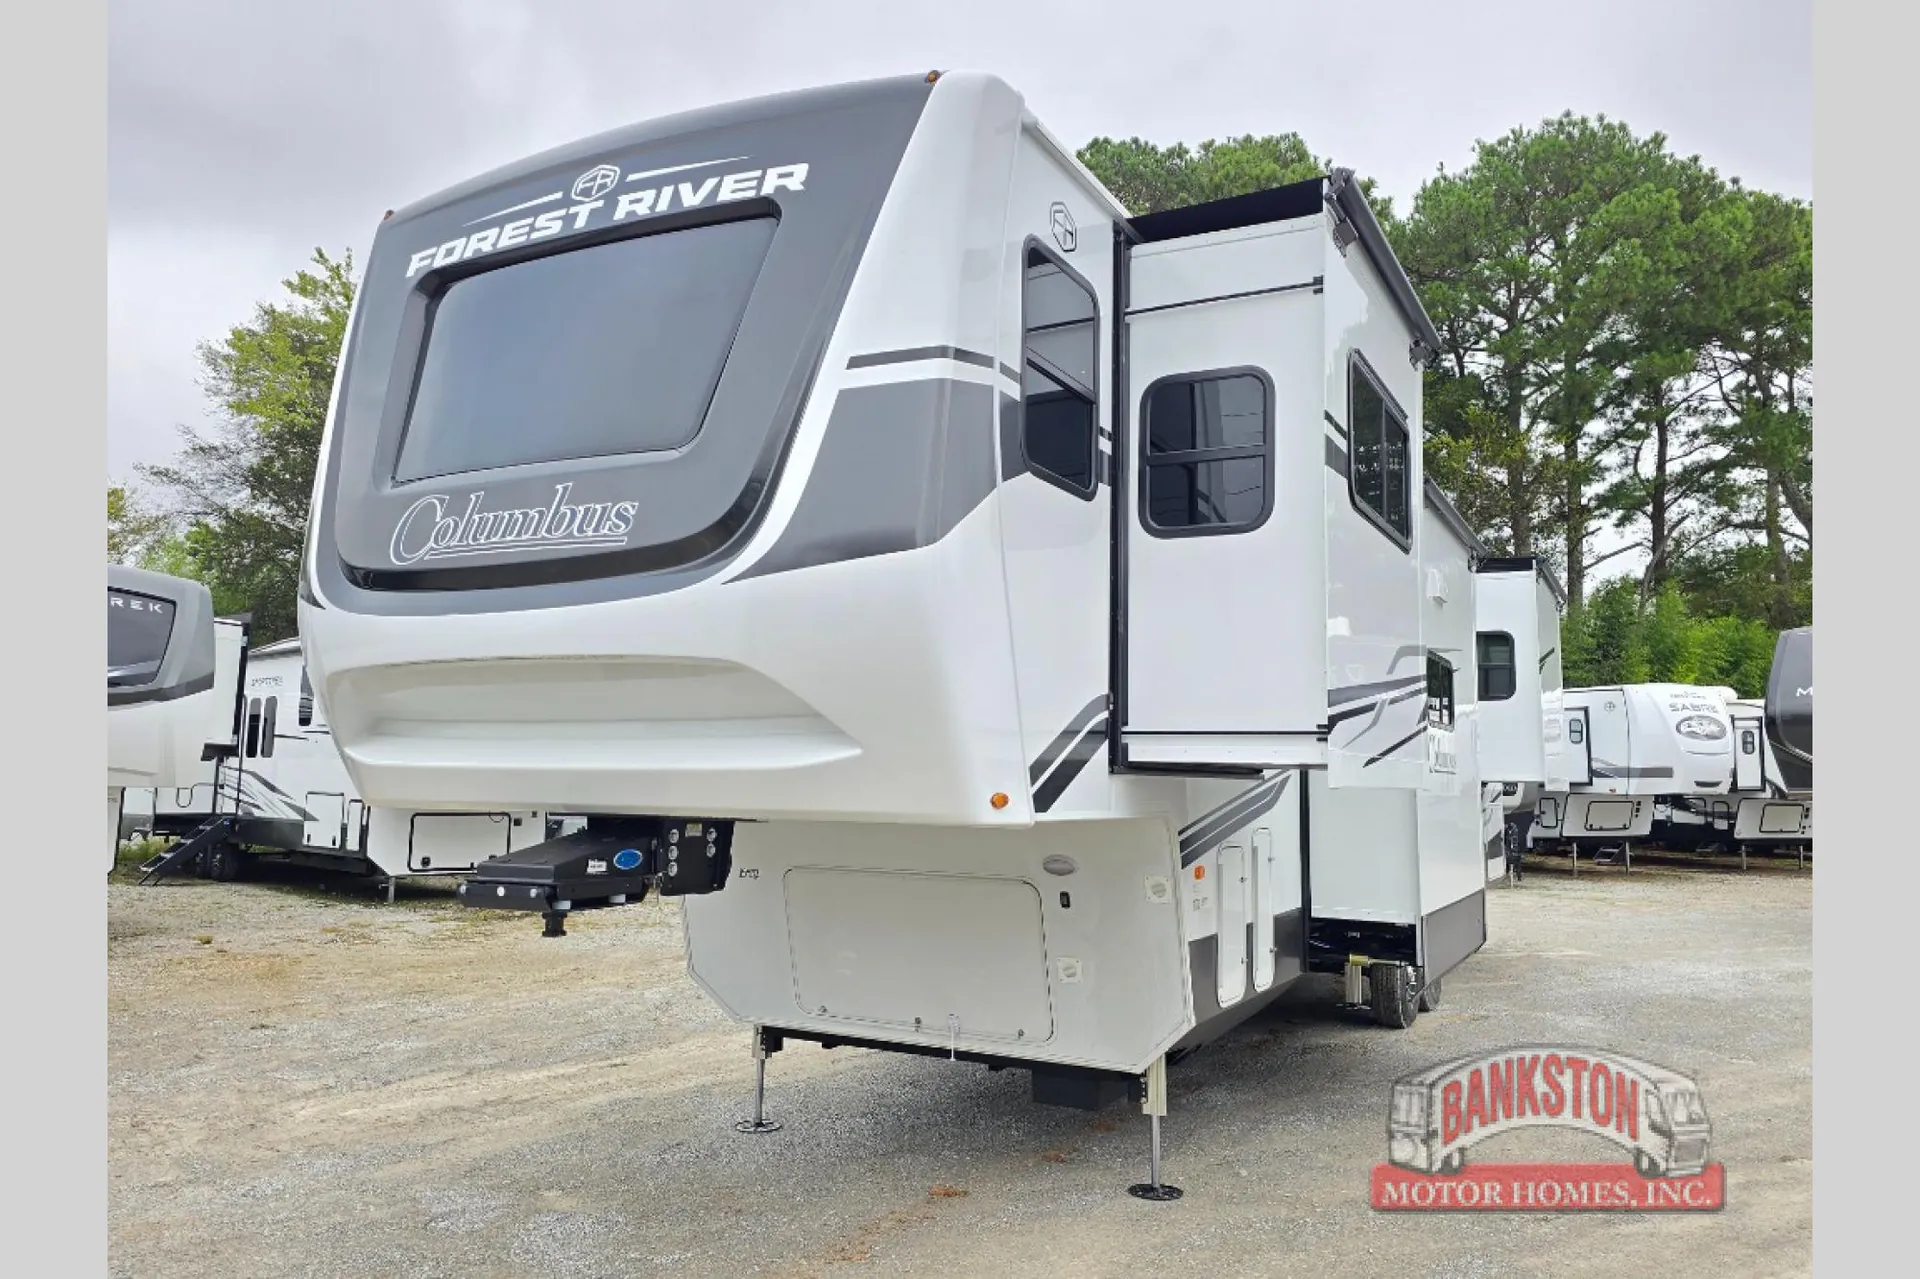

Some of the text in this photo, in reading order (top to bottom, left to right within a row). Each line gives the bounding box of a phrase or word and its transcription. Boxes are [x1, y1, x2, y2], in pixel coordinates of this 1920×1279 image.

[405, 162, 810, 278] FOREST RIVER
[390, 481, 640, 566] Columbus
